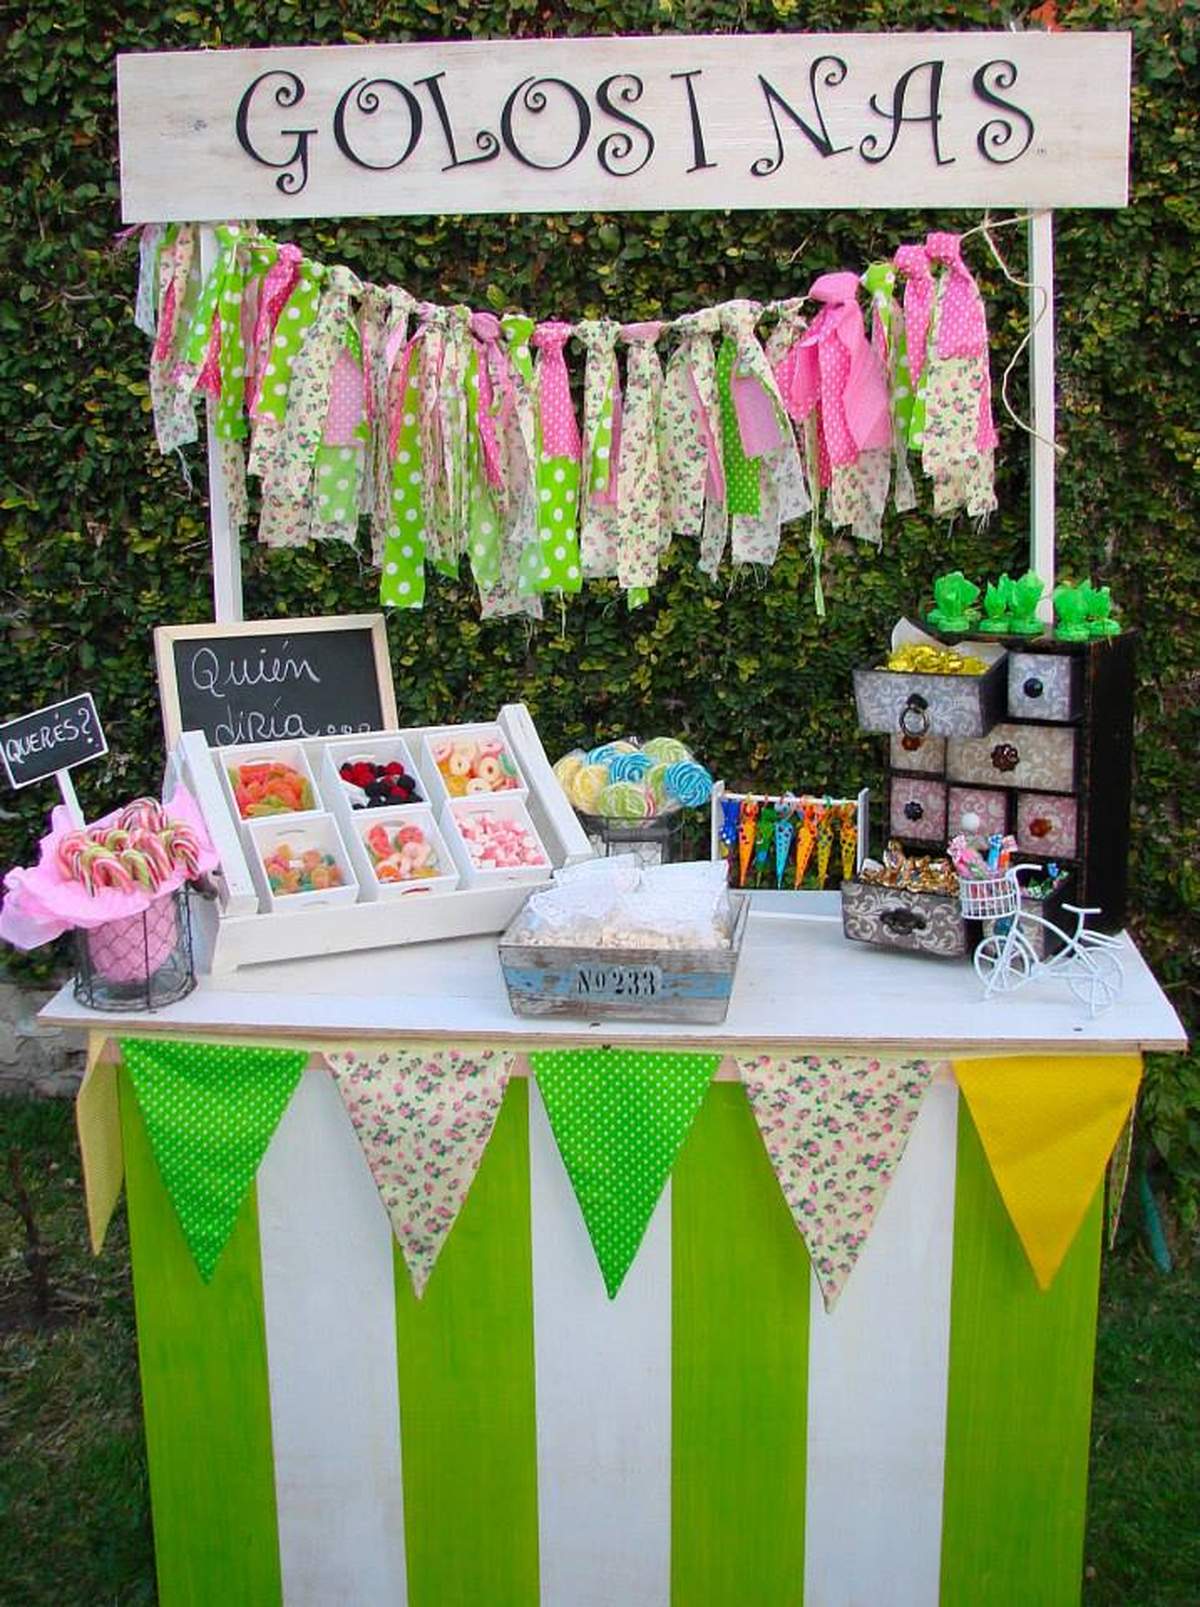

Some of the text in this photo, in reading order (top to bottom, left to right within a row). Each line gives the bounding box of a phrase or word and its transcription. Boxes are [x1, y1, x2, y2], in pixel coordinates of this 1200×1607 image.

[235, 55, 1035, 194] GOLOSINAS
[191, 639, 321, 698] Quién
[612, 970, 656, 995] 233
